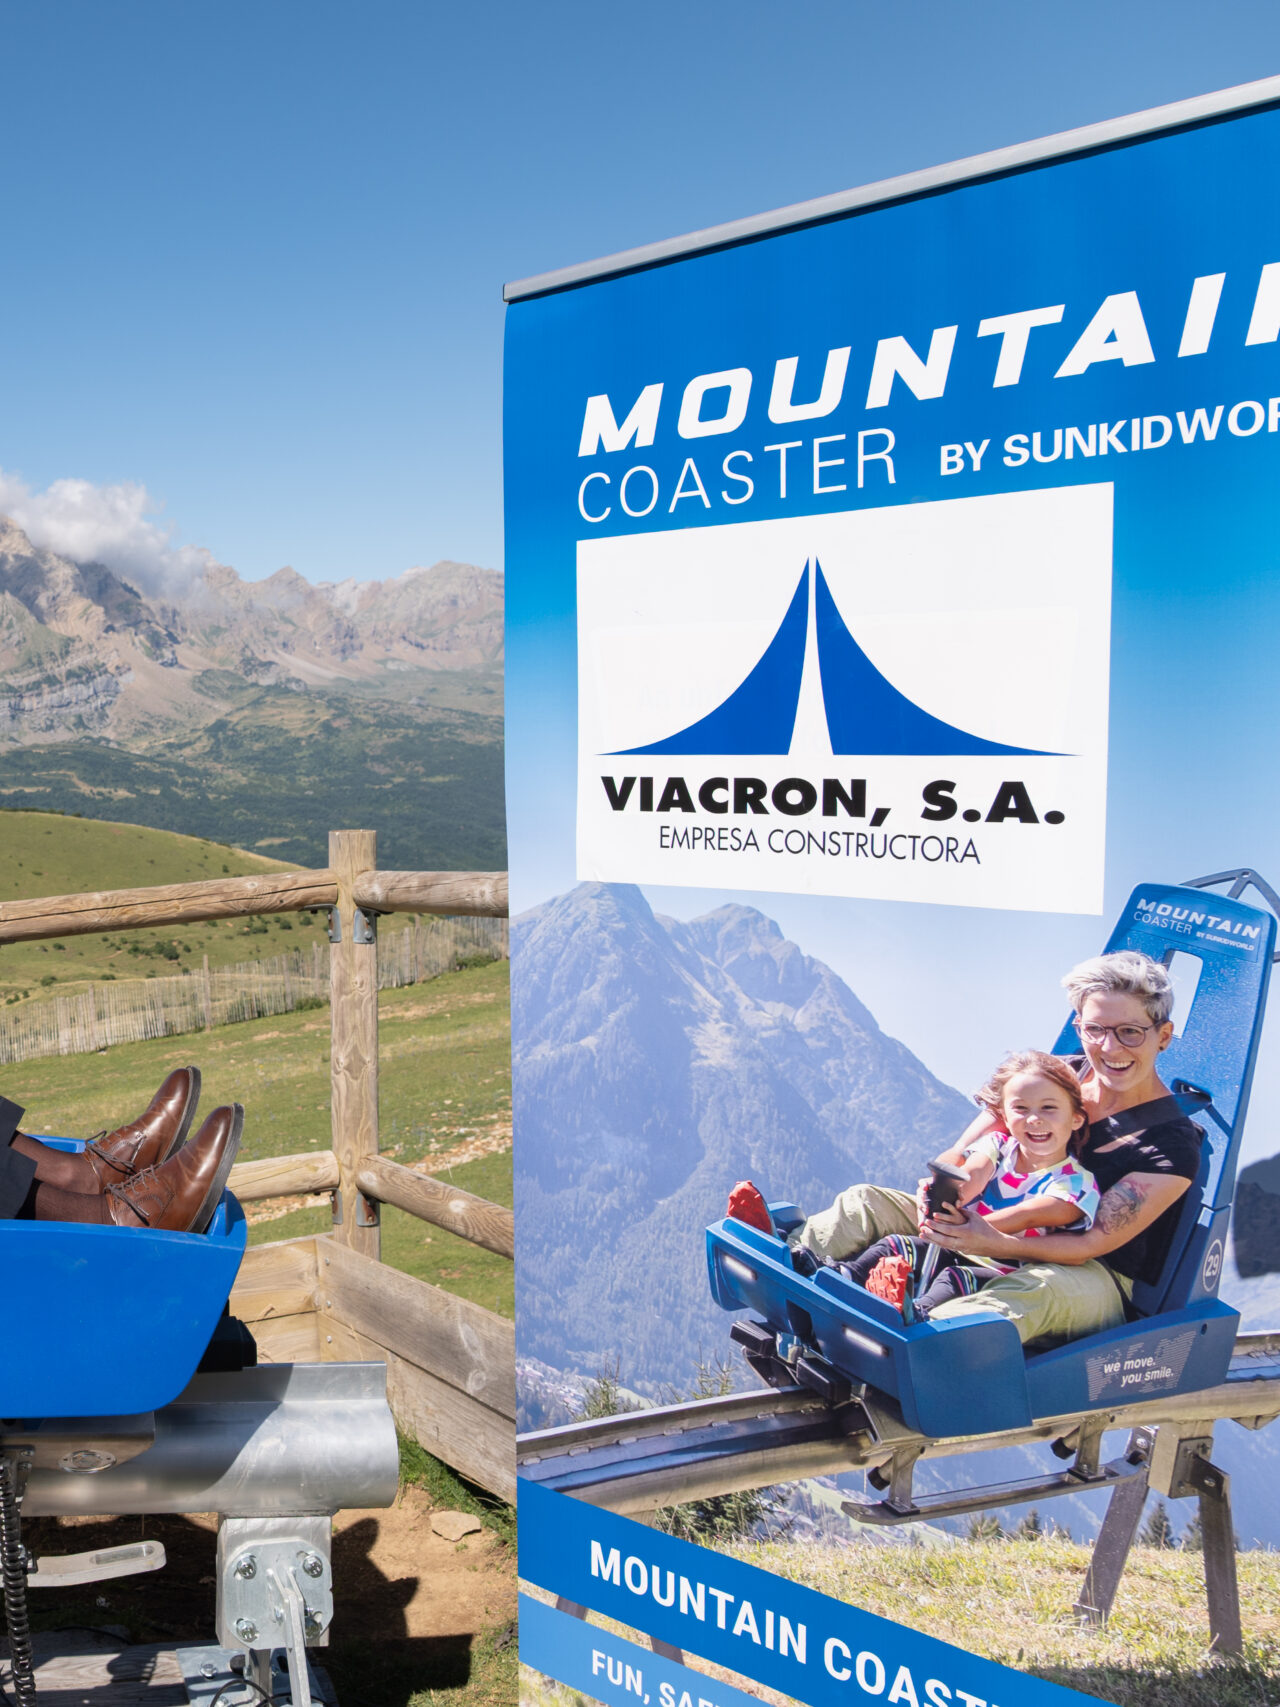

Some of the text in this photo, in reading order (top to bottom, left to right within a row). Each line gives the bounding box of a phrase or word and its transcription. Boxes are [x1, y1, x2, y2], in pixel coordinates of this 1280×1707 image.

[578, 428, 896, 523] COASTER
[939, 438, 991, 476] BY
[600, 775, 1066, 827] VIACRON, S.A.
[660, 825, 981, 864] EMPRESA CONSTRUCTORA
[1133, 910, 1193, 935] COASTER
[1136, 898, 1261, 939] MOUNTAIN
[1205, 1253, 1220, 1277] 29
[1104, 1356, 1156, 1374] we move.
[1121, 1365, 1174, 1388] you smile.
[590, 1539, 1000, 1707] MOUNTAIN COAS
[592, 1649, 650, 1705] FUN,
